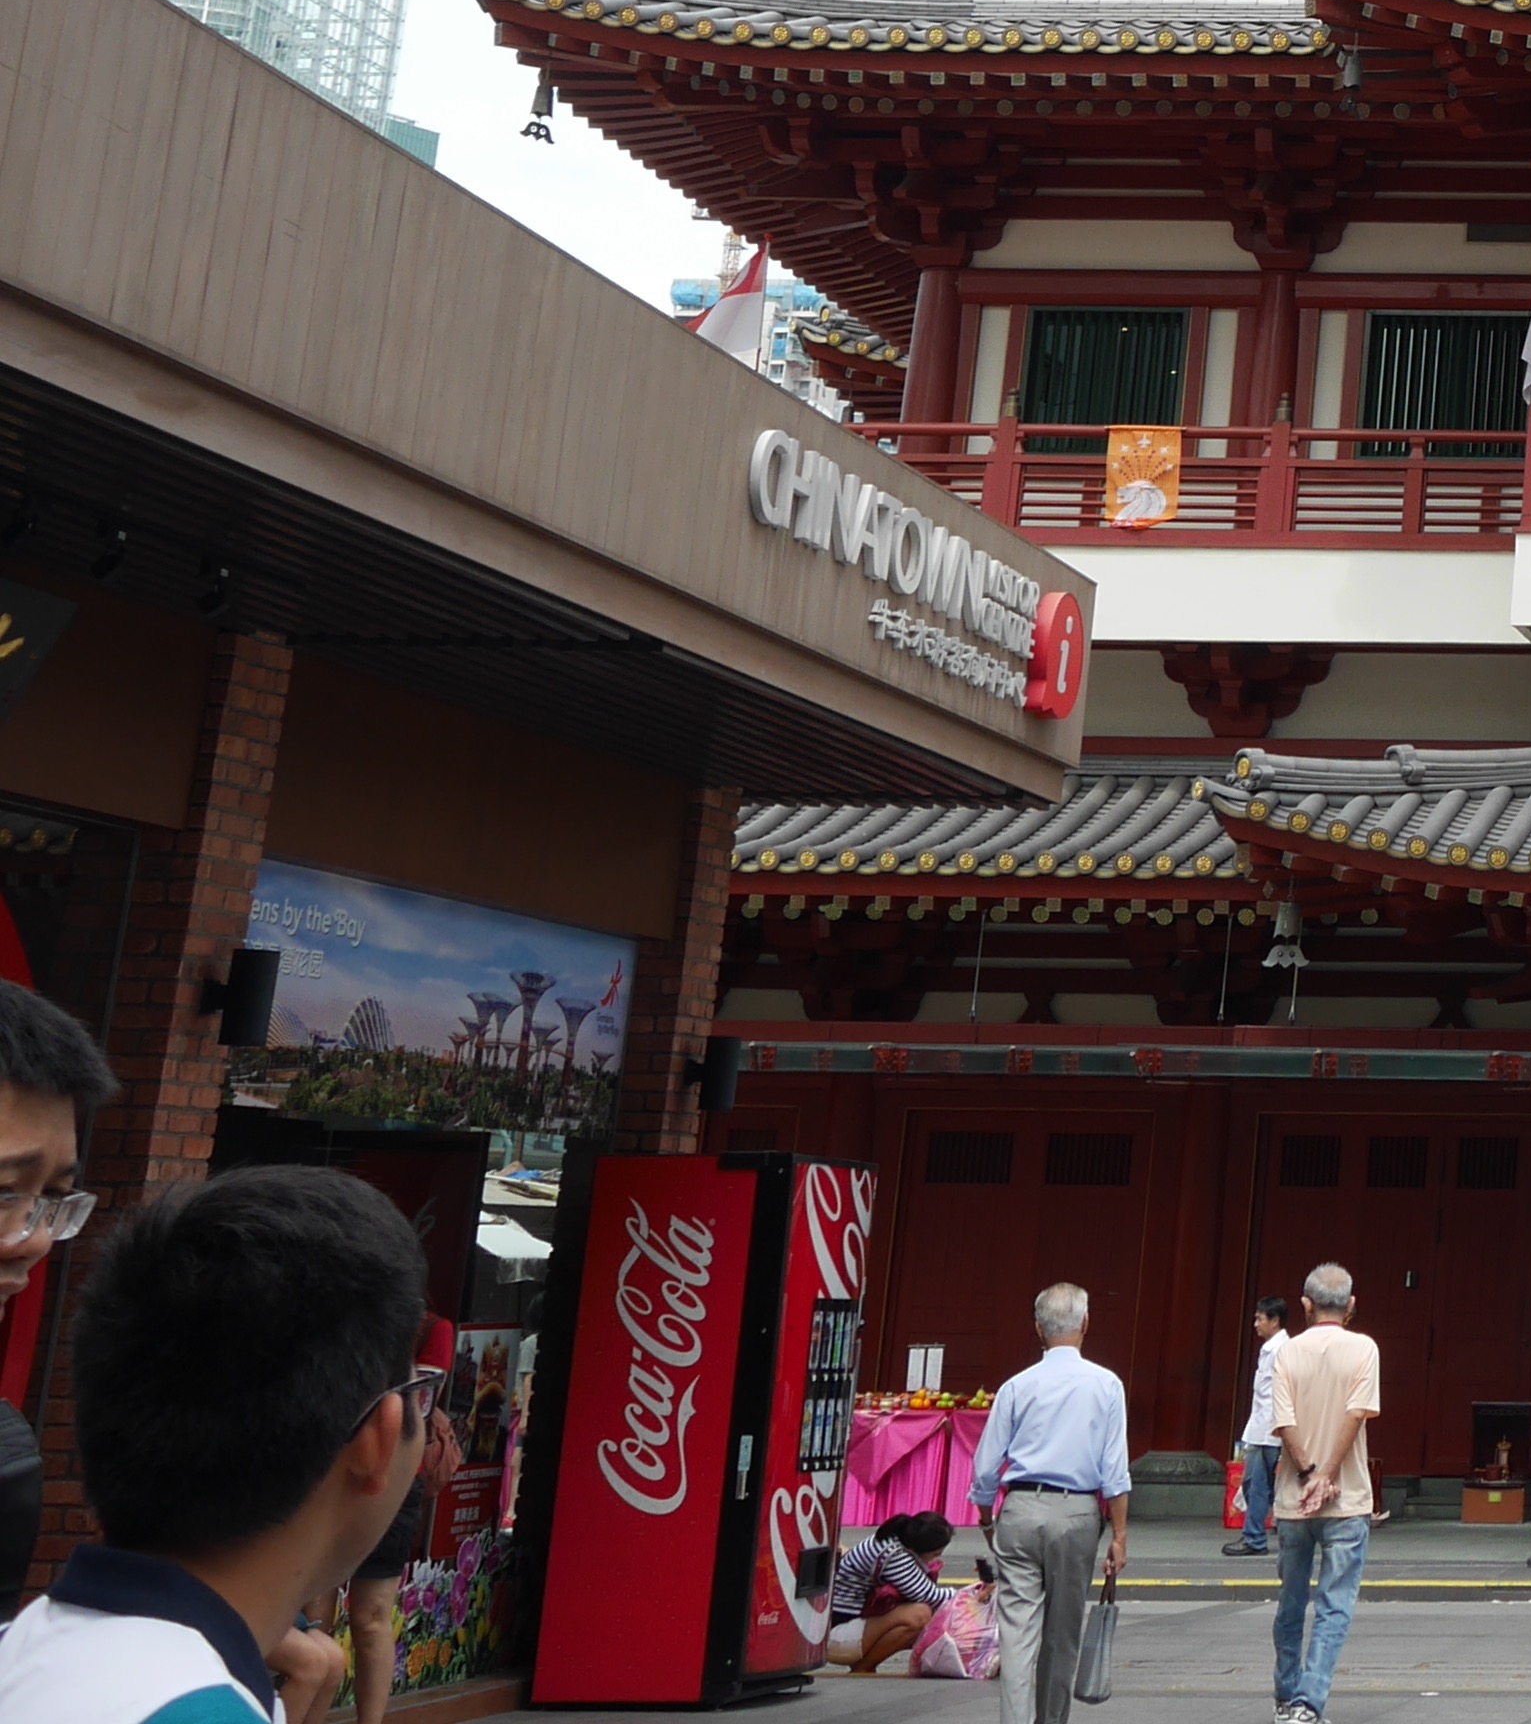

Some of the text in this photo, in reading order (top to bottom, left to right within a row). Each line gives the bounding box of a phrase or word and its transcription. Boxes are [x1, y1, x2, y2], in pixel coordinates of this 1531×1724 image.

[750, 430, 988, 633] CHINATOWN
[984, 559, 1041, 620] VISITOR
[979, 597, 1036, 660] CENTRE
[282, 897, 304, 937] by
[306, 903, 332, 935] the
[334, 907, 367, 948] Bay
[598, 1196, 717, 1516] Coca-Cola
